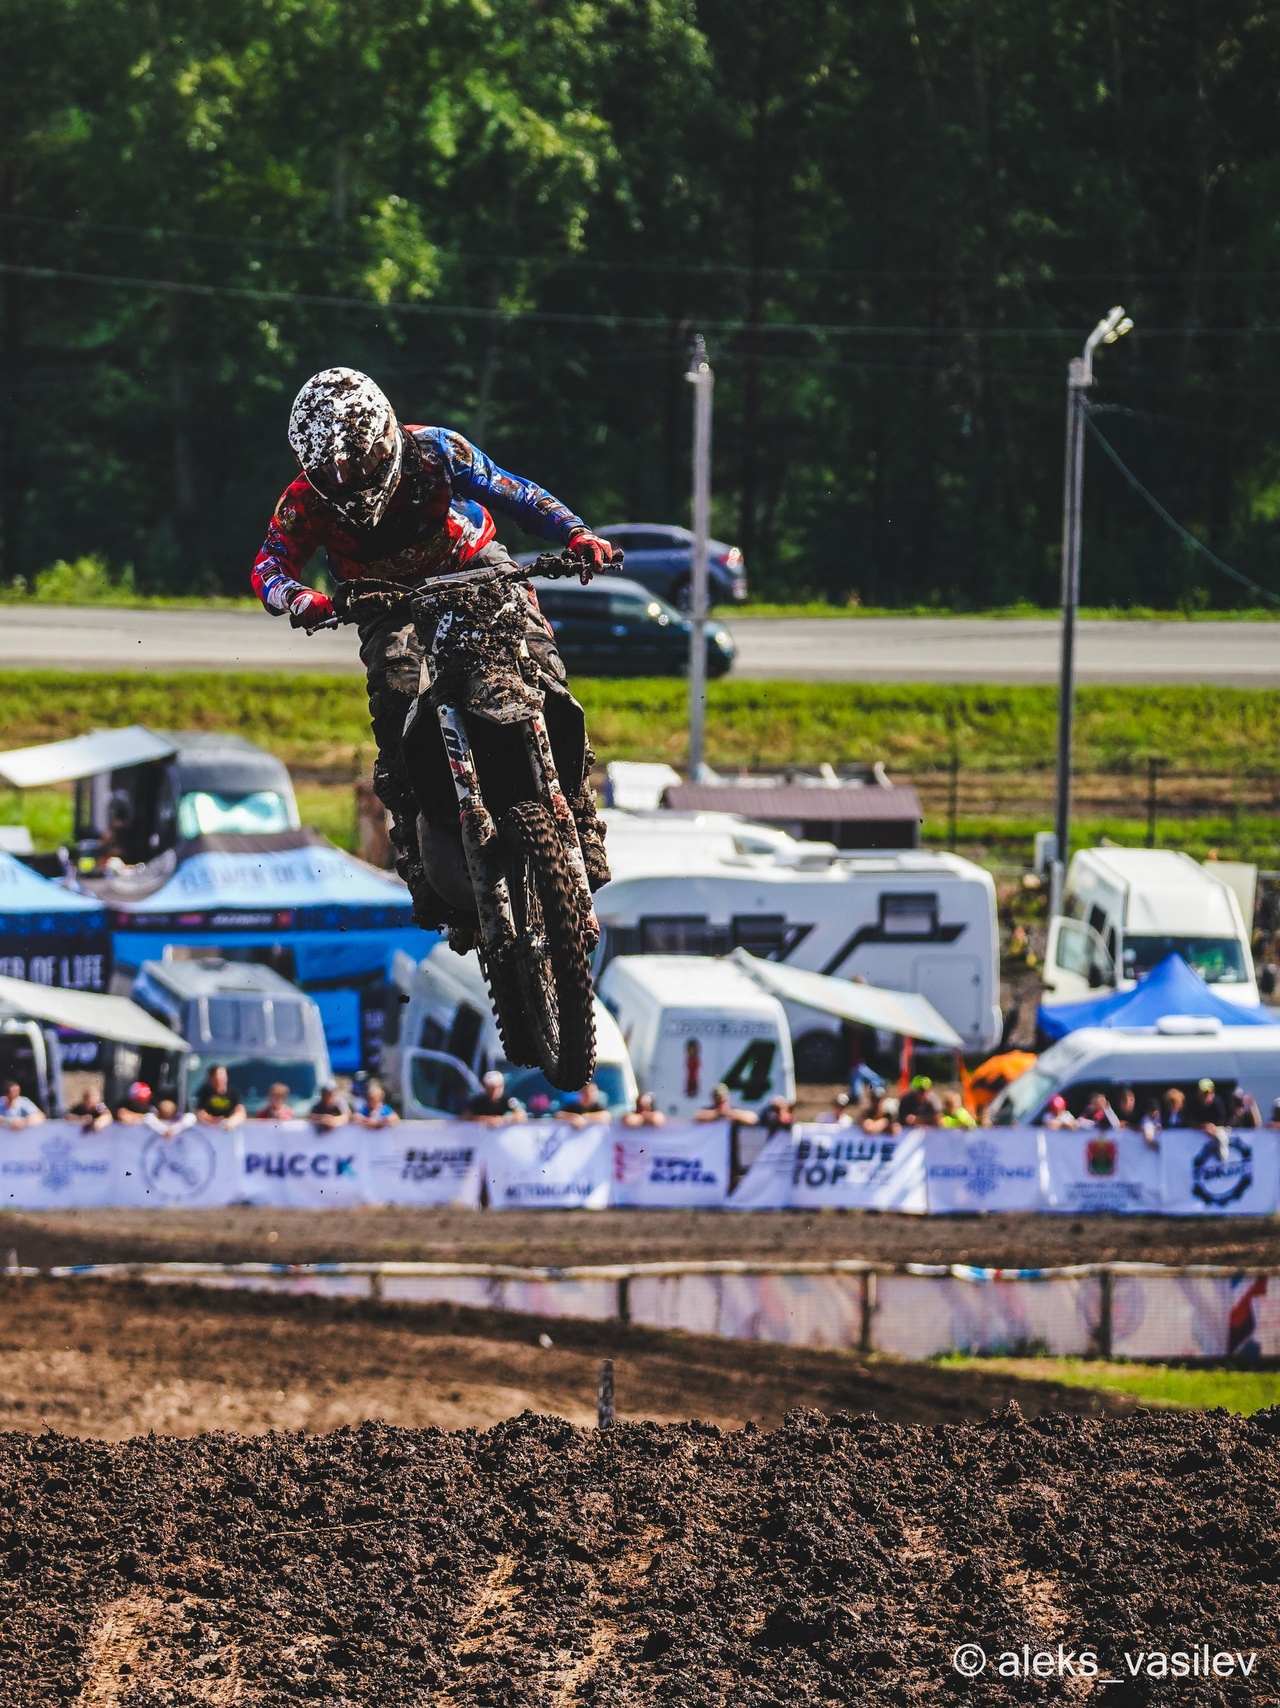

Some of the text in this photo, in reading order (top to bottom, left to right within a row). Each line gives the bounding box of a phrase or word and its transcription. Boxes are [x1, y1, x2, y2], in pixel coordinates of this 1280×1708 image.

[60, 954, 104, 989] LIFE
[720, 1038, 776, 1101] 4
[245, 1152, 356, 1178] РЦССК
[797, 1141, 896, 1163] ВЫШЕ
[792, 1163, 848, 1187] ГОР
